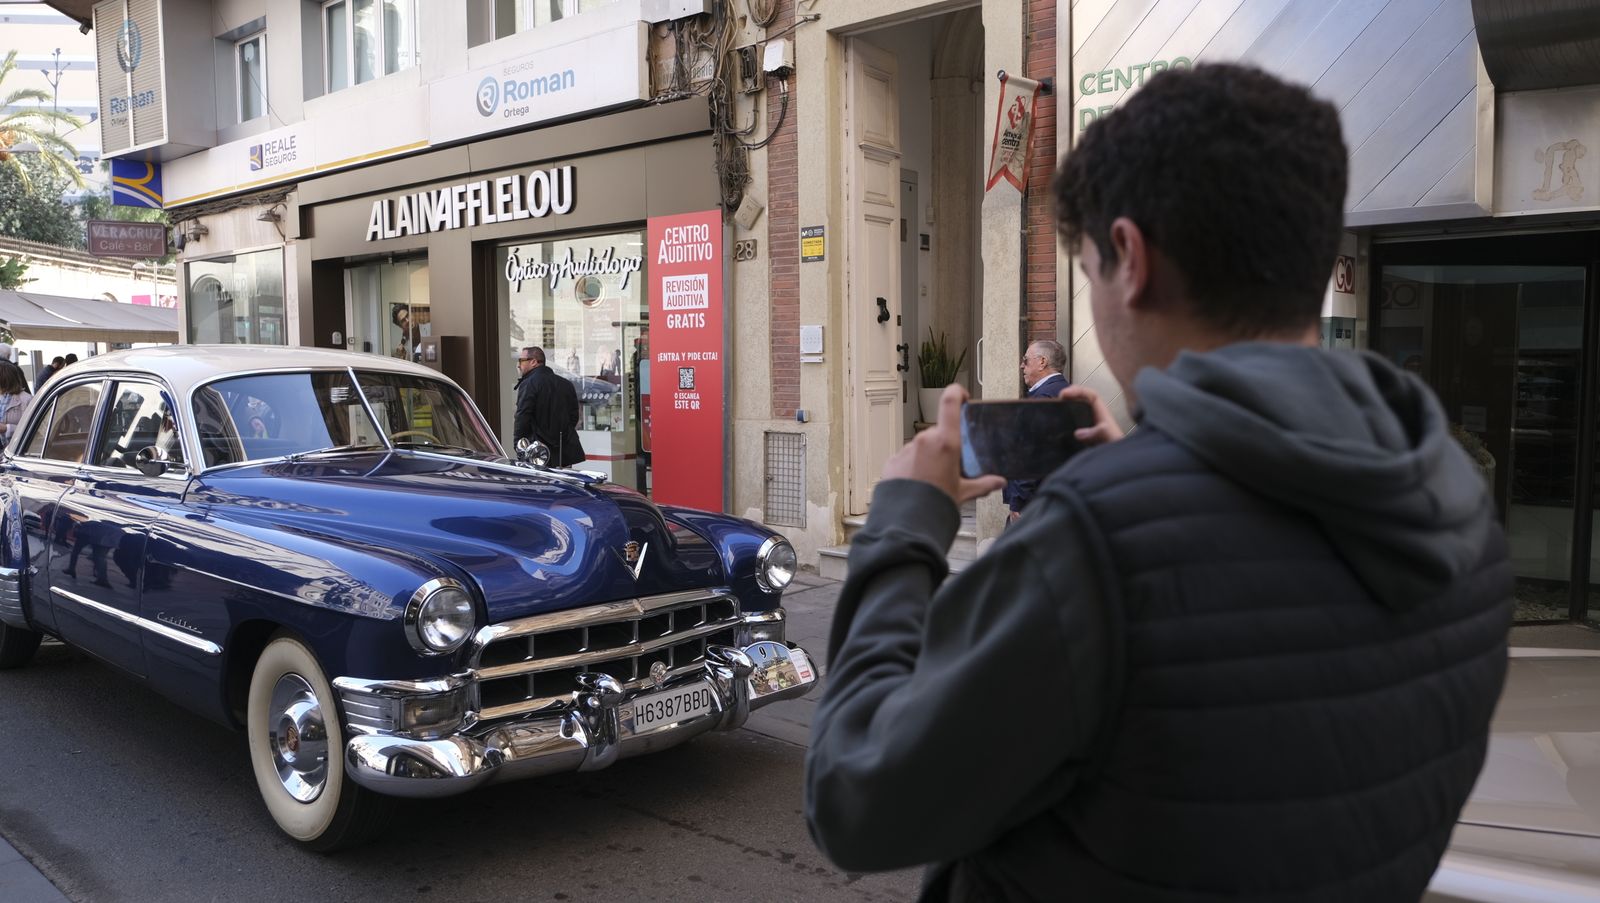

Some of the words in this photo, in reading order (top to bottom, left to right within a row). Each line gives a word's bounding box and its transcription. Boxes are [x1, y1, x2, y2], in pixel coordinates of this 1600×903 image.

[504, 61, 534, 76] SEGUROS
[504, 69, 575, 103] Roman
[110, 90, 154, 115] Roman
[504, 106, 529, 118] Ortega
[265, 135, 296, 156] REALE
[265, 151, 296, 167] SEGUROS
[91, 224, 162, 239] VERACRUZ
[665, 224, 709, 246] CENTRO
[134, 242, 153, 251] Bar
[658, 240, 712, 264] AUDITIVO
[736, 241, 755, 261] 28
[506, 248, 548, 292] Óptico
[550, 261, 561, 289] y
[561, 247, 642, 290] Audiólogo
[666, 276, 705, 293] REVISIÓN
[667, 294, 704, 308] AUDITIVA
[667, 313, 705, 329] GRATIS
[658, 352, 680, 362] ¡ENTRA
[682, 352, 686, 361] Y
[688, 352, 701, 361] PIDE
[702, 351, 718, 361] CITA!
[674, 400, 689, 409] ESTE
[691, 400, 700, 410] QR
[758, 646, 767, 659] 9
[635, 688, 710, 726] H6387BBD
